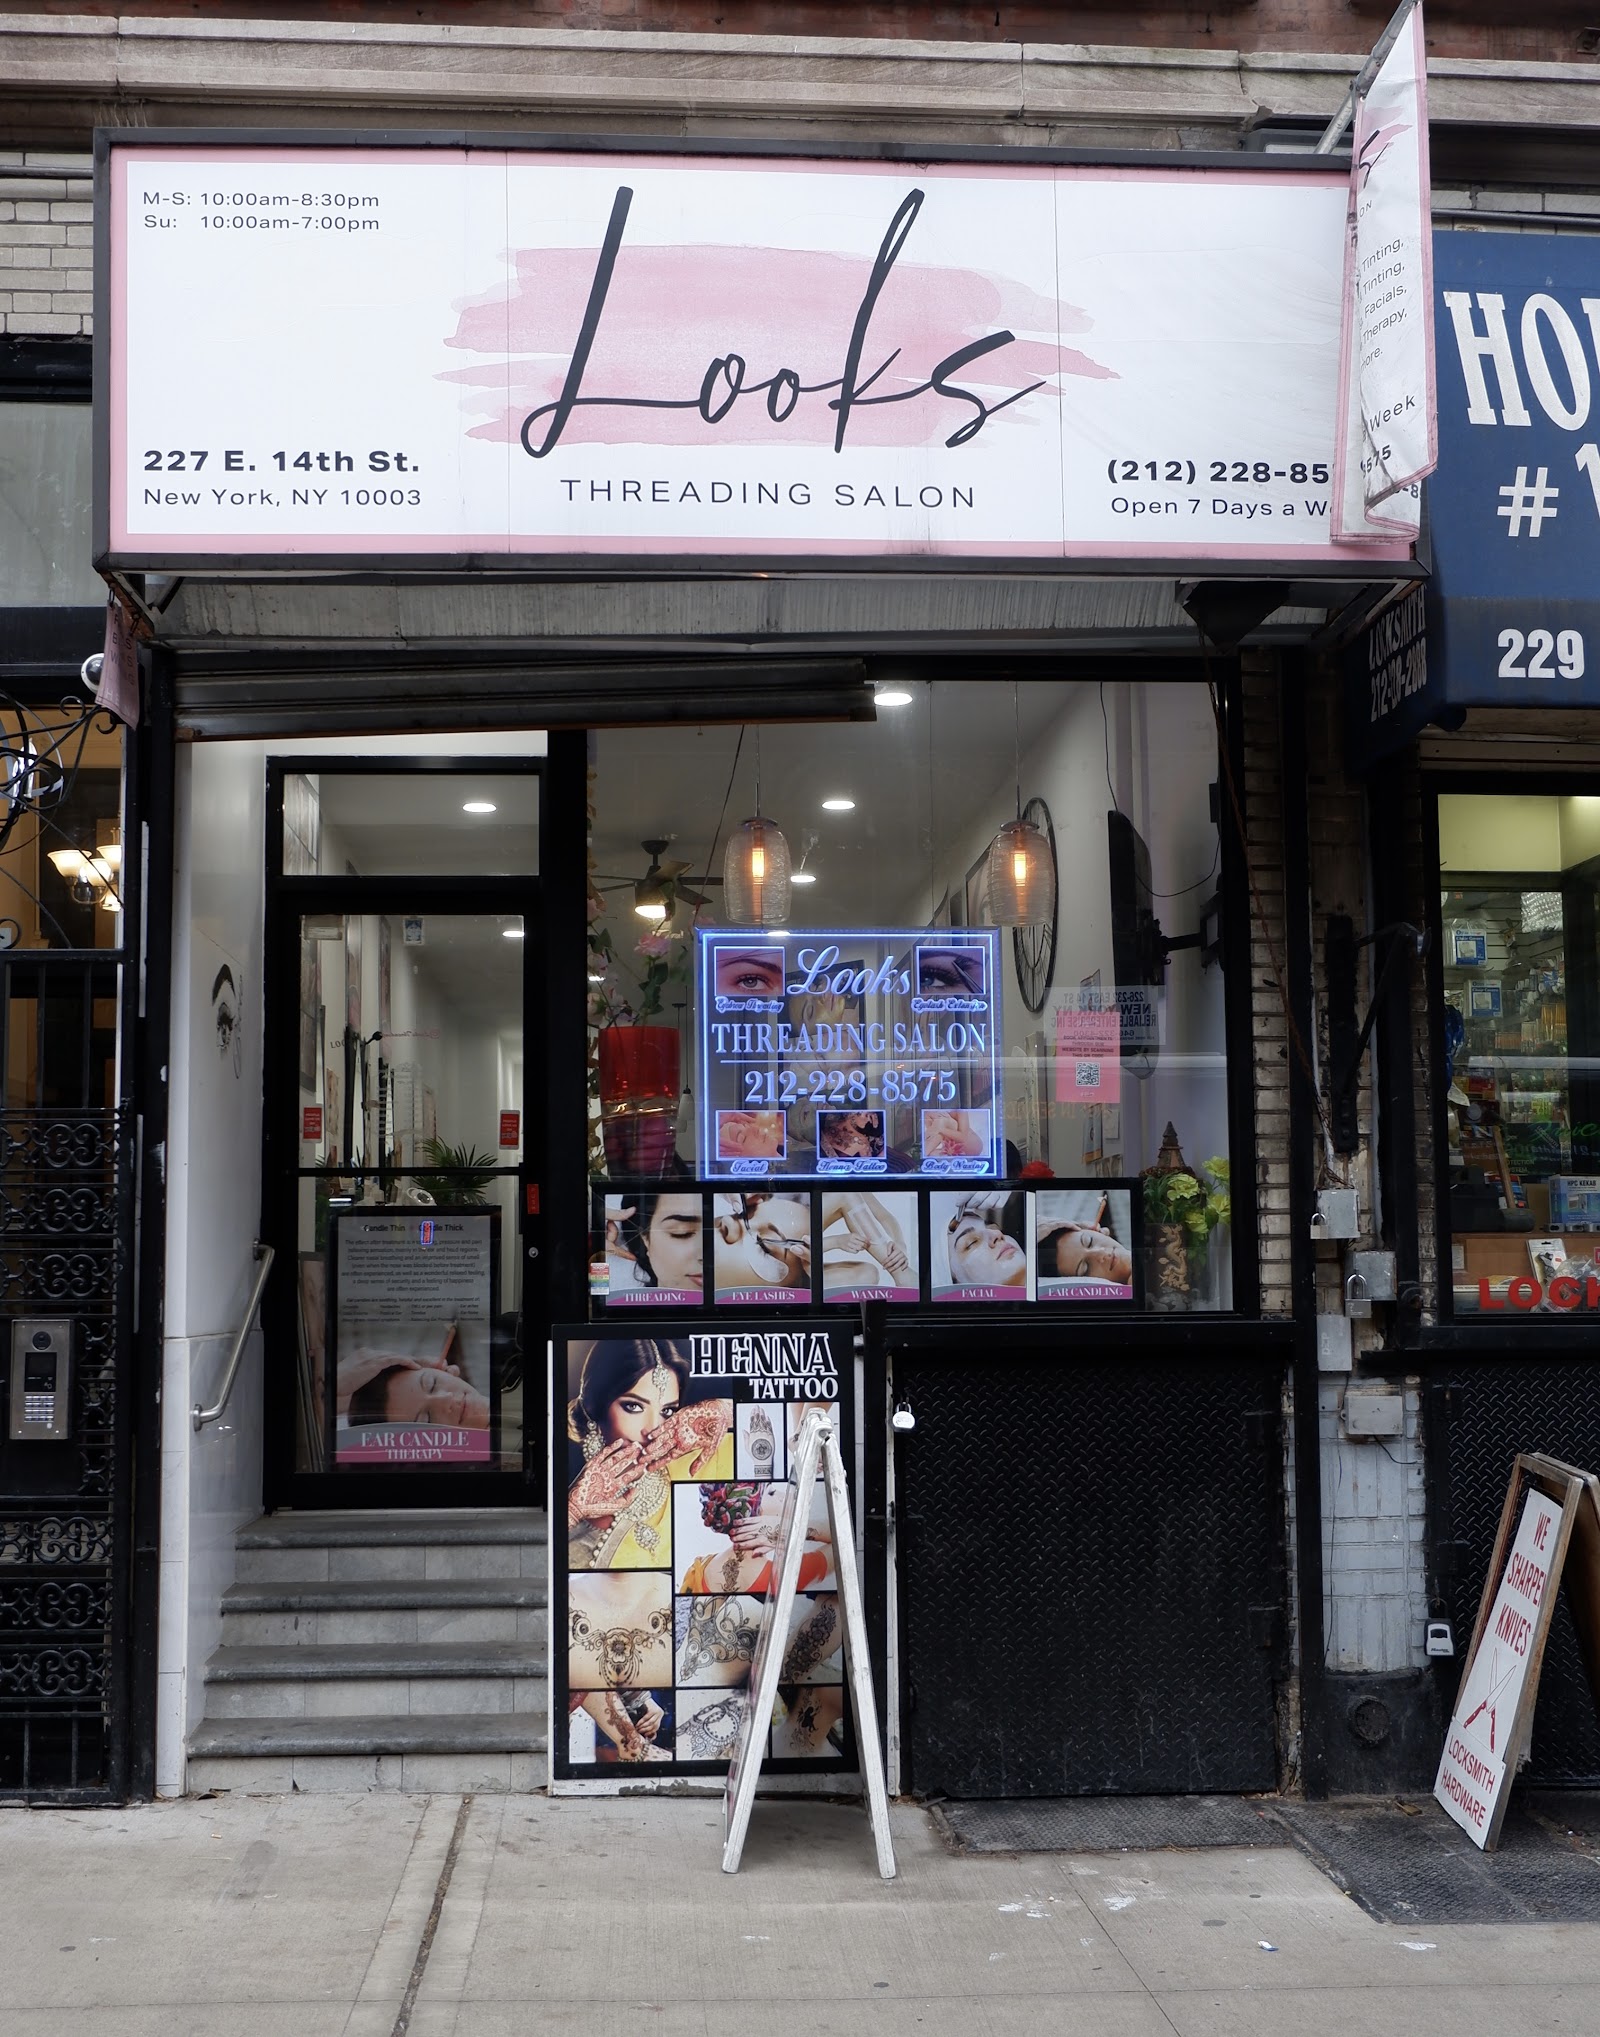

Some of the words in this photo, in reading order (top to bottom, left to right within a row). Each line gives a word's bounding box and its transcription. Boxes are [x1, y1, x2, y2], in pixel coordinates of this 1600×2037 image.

[143, 191, 191, 206] M-S:
[200, 192, 380, 210] 10:00am-8:30pm
[143, 214, 177, 229] Su:
[200, 215, 380, 233] 10:00am-7:00pm
[1361, 237, 1404, 273] Tinting,
[1362, 261, 1405, 296] Tinting,
[1364, 284, 1407, 319] Facials,
[520, 185, 1046, 458] Looks
[1362, 307, 1408, 345] Therapy,
[1443, 291, 1600, 431] HO
[1369, 394, 1416, 432] Week
[143, 450, 209, 472] 227
[224, 450, 256, 472] E.
[272, 450, 354, 472] 14th
[368, 450, 419, 472] St.
[1107, 459, 1196, 485] (212)
[1209, 461, 1335, 484] 228-85
[144, 488, 201, 505] New
[211, 488, 281, 507] York,
[292, 488, 329, 505] NY
[340, 489, 421, 506] 10003
[560, 479, 812, 506] THREADING
[834, 483, 975, 509] SALON
[1111, 497, 1178, 517] Open
[1187, 499, 1201, 515] 7
[1212, 499, 1272, 519] Days
[1282, 502, 1295, 516] a
[1368, 582, 1427, 671] LOCKSMITH
[1497, 628, 1586, 680] 229
[787, 945, 911, 996] Looks
[711, 1023, 886, 1054] THREADING
[893, 1022, 987, 1053] SALON
[744, 1070, 957, 1104] 212-228-8575
[624, 1292, 686, 1302] THREADING
[754, 1291, 795, 1301] LASHES
[851, 1289, 893, 1299] WAXING
[961, 1288, 997, 1298] FACIAL
[1048, 1287, 1070, 1297] EAR
[1071, 1286, 1123, 1297] CANDLING
[688, 1332, 838, 1378] HENNA
[749, 1377, 839, 1400] TATTOO
[361, 1431, 395, 1448] EAR
[399, 1431, 470, 1447] CANDLE
[385, 1448, 444, 1460] THERAPY
[1532, 1511, 1552, 1552] WE
[1494, 1602, 1532, 1657] KNIVES
[1447, 1733, 1496, 1795] LOCKSMITH
[1440, 1769, 1487, 1829] HARDWARE
